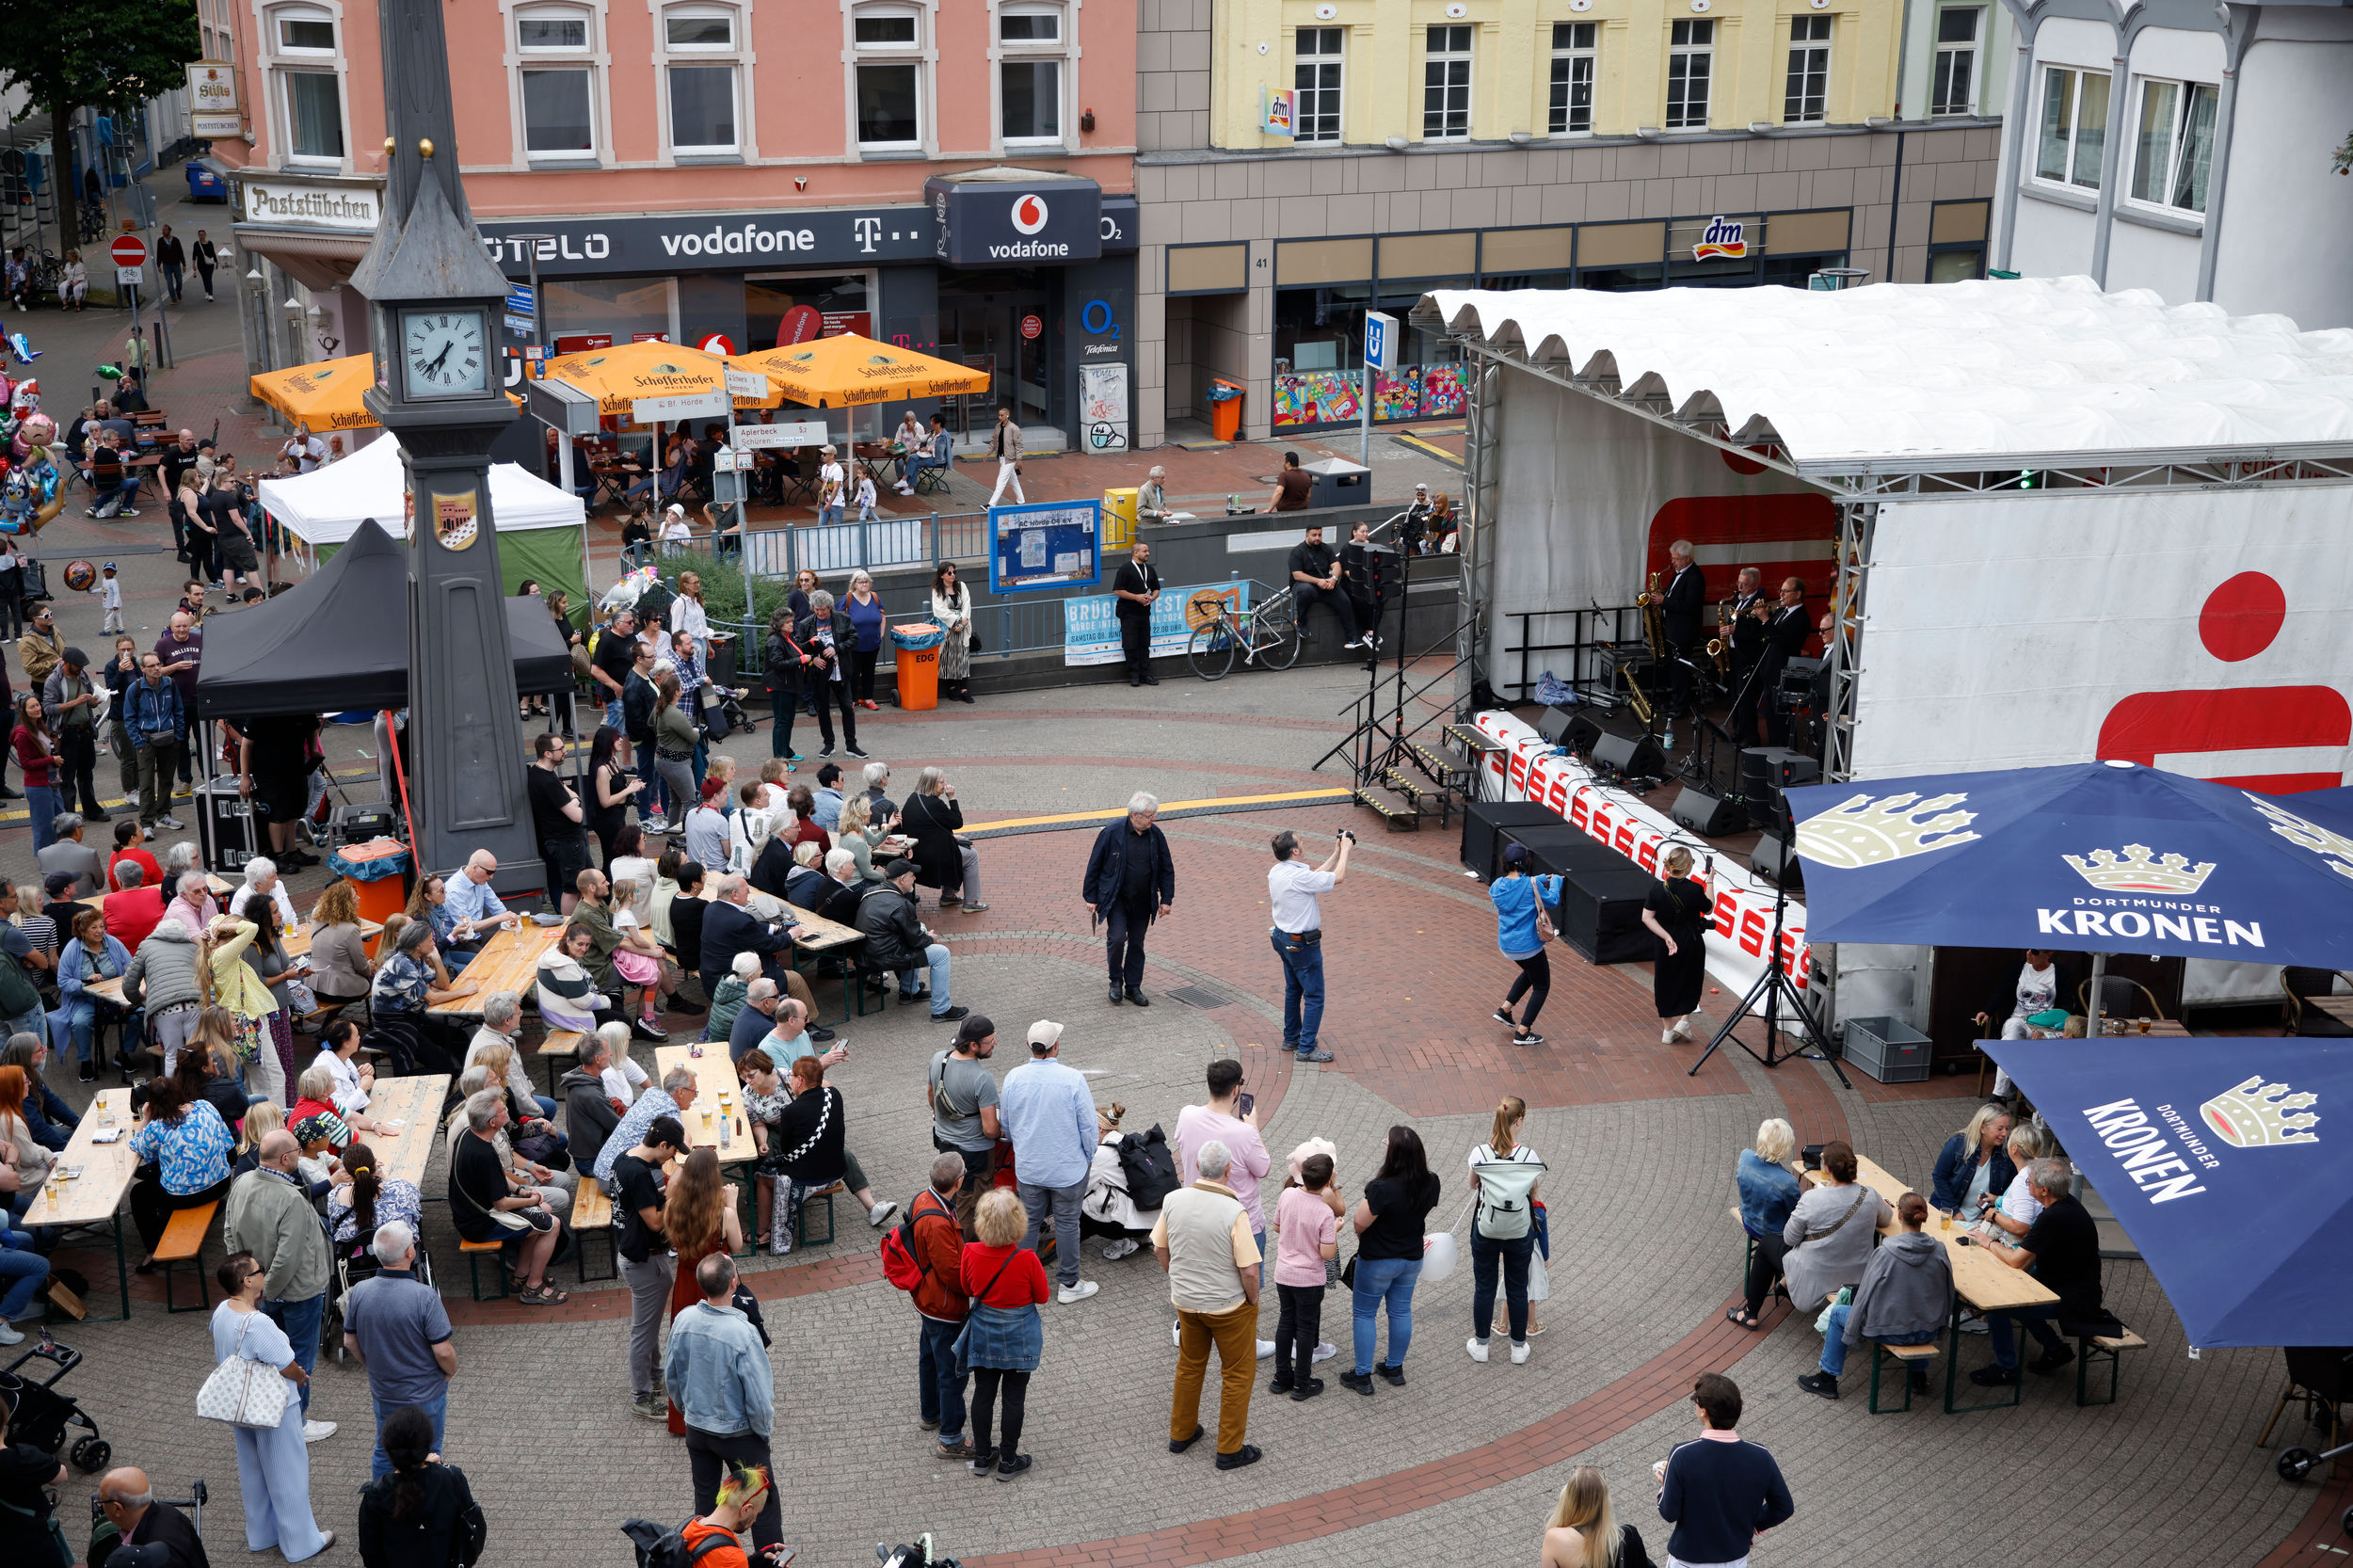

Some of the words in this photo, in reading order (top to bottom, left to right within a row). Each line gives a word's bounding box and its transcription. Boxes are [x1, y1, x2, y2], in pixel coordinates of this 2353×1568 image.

[1273, 96, 1288, 117] dm
[197, 121, 239, 130] POSTSTÜBCHEN
[252, 186, 372, 220] Poststübchen
[661, 223, 815, 256] vodafone
[1705, 217, 1741, 244] dm
[989, 240, 1069, 259] vodafone
[1256, 258, 1268, 268] 41
[792, 311, 808, 345] vodafone
[1082, 299, 1122, 340] O2
[1084, 344, 1118, 356] Telefónica
[858, 363, 928, 378] Schöfferhofer
[633, 375, 714, 388] Schöfferhofer
[778, 380, 809, 402] Schöfferhofer
[928, 378, 972, 395] Schöfferhofer
[602, 395, 632, 413] Schöffe
[681, 397, 704, 407] Hörde
[843, 386, 889, 405] Schöfferhofer
[330, 410, 378, 429] Schöfferho
[741, 426, 778, 437] Aplerbeck
[741, 437, 771, 446] Schüren
[1030, 519, 1049, 527] Hörde
[1071, 620, 1096, 632] HÖRDE
[1162, 612, 1183, 622] 2024
[1071, 632, 1096, 643] SAMSTAG
[1170, 624, 1182, 632] UHR
[171, 648, 200, 657] HOLLISTER
[916, 653, 935, 663] EDG
[2073, 897, 2221, 914] DORTMUNDER
[2037, 908, 2265, 948] KRONEN
[2156, 1103, 2220, 1170] DORTMUNDER
[2082, 1097, 2207, 1205] KRONEN
